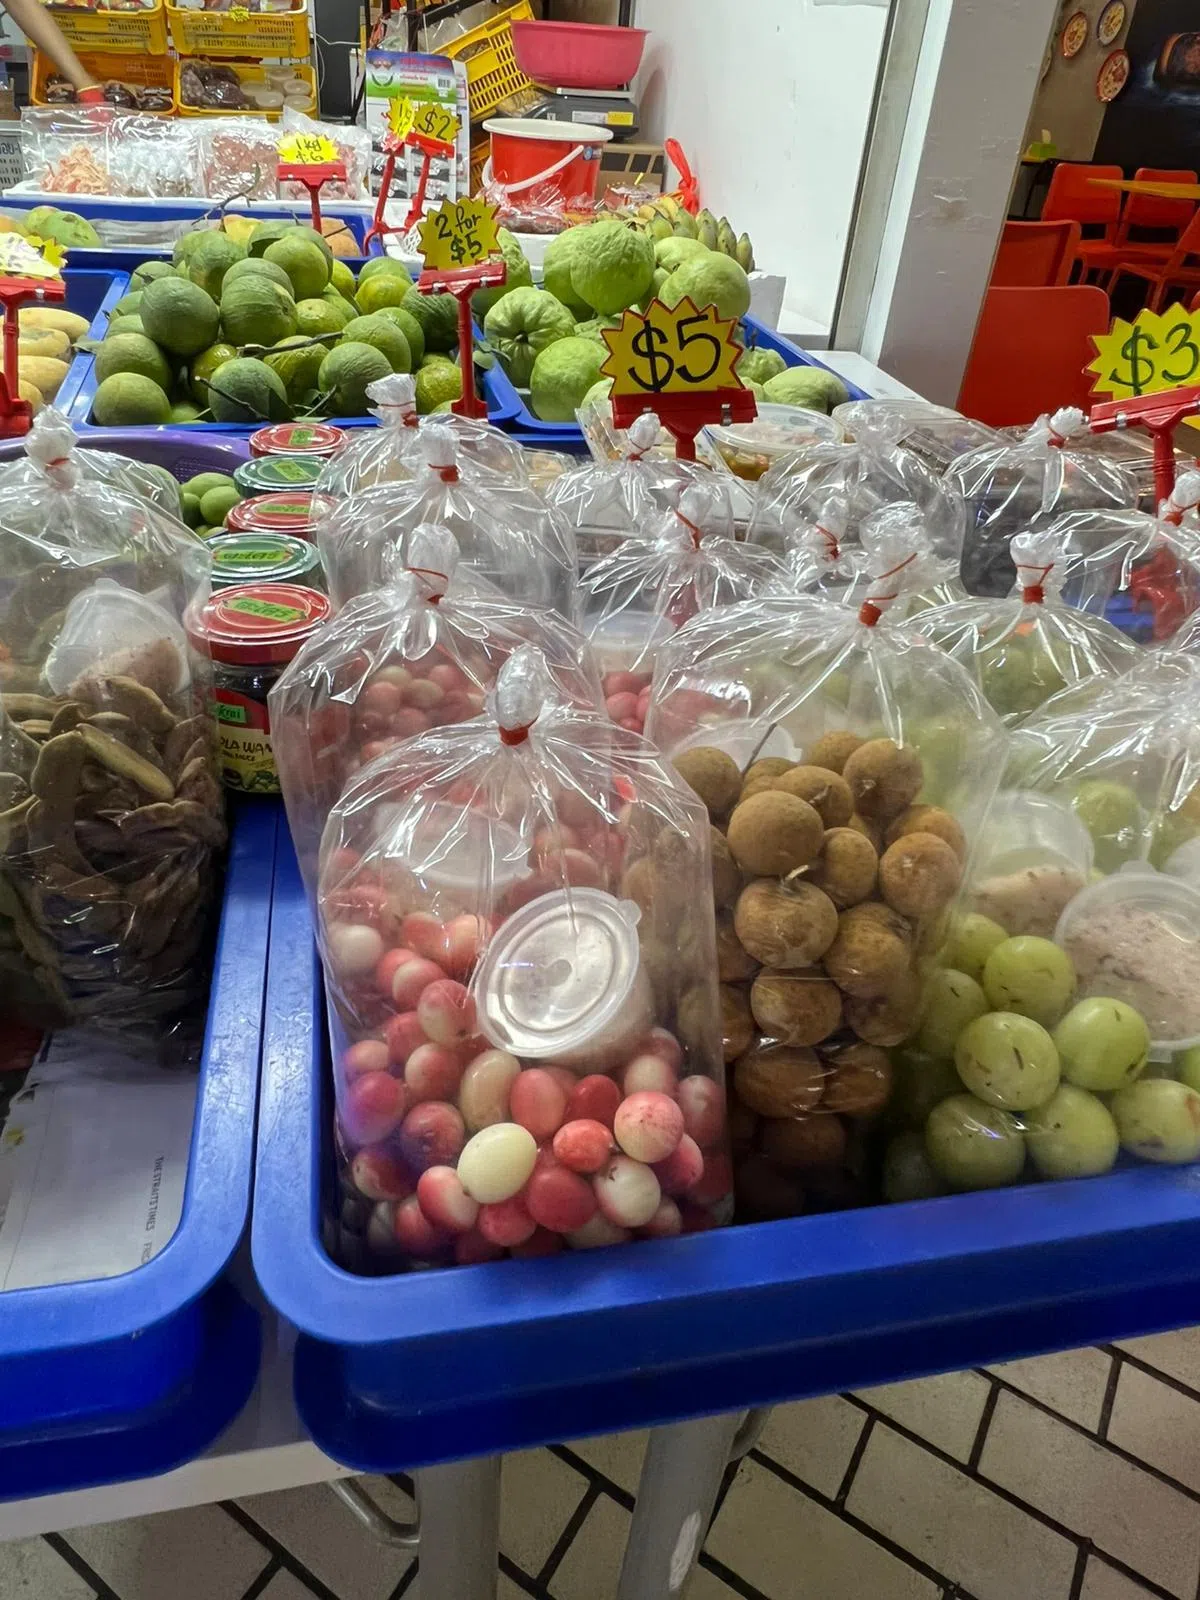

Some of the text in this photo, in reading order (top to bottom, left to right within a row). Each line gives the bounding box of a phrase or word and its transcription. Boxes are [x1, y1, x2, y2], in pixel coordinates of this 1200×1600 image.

[417, 107, 448, 141] $2
[434, 205, 482, 239] 2 for
[450, 229, 482, 264] $5
[627, 314, 721, 393] $5
[1108, 322, 1199, 396] $3
[149, 1171, 162, 1206] STRAITS
[145, 1206, 158, 1231] TIMES
